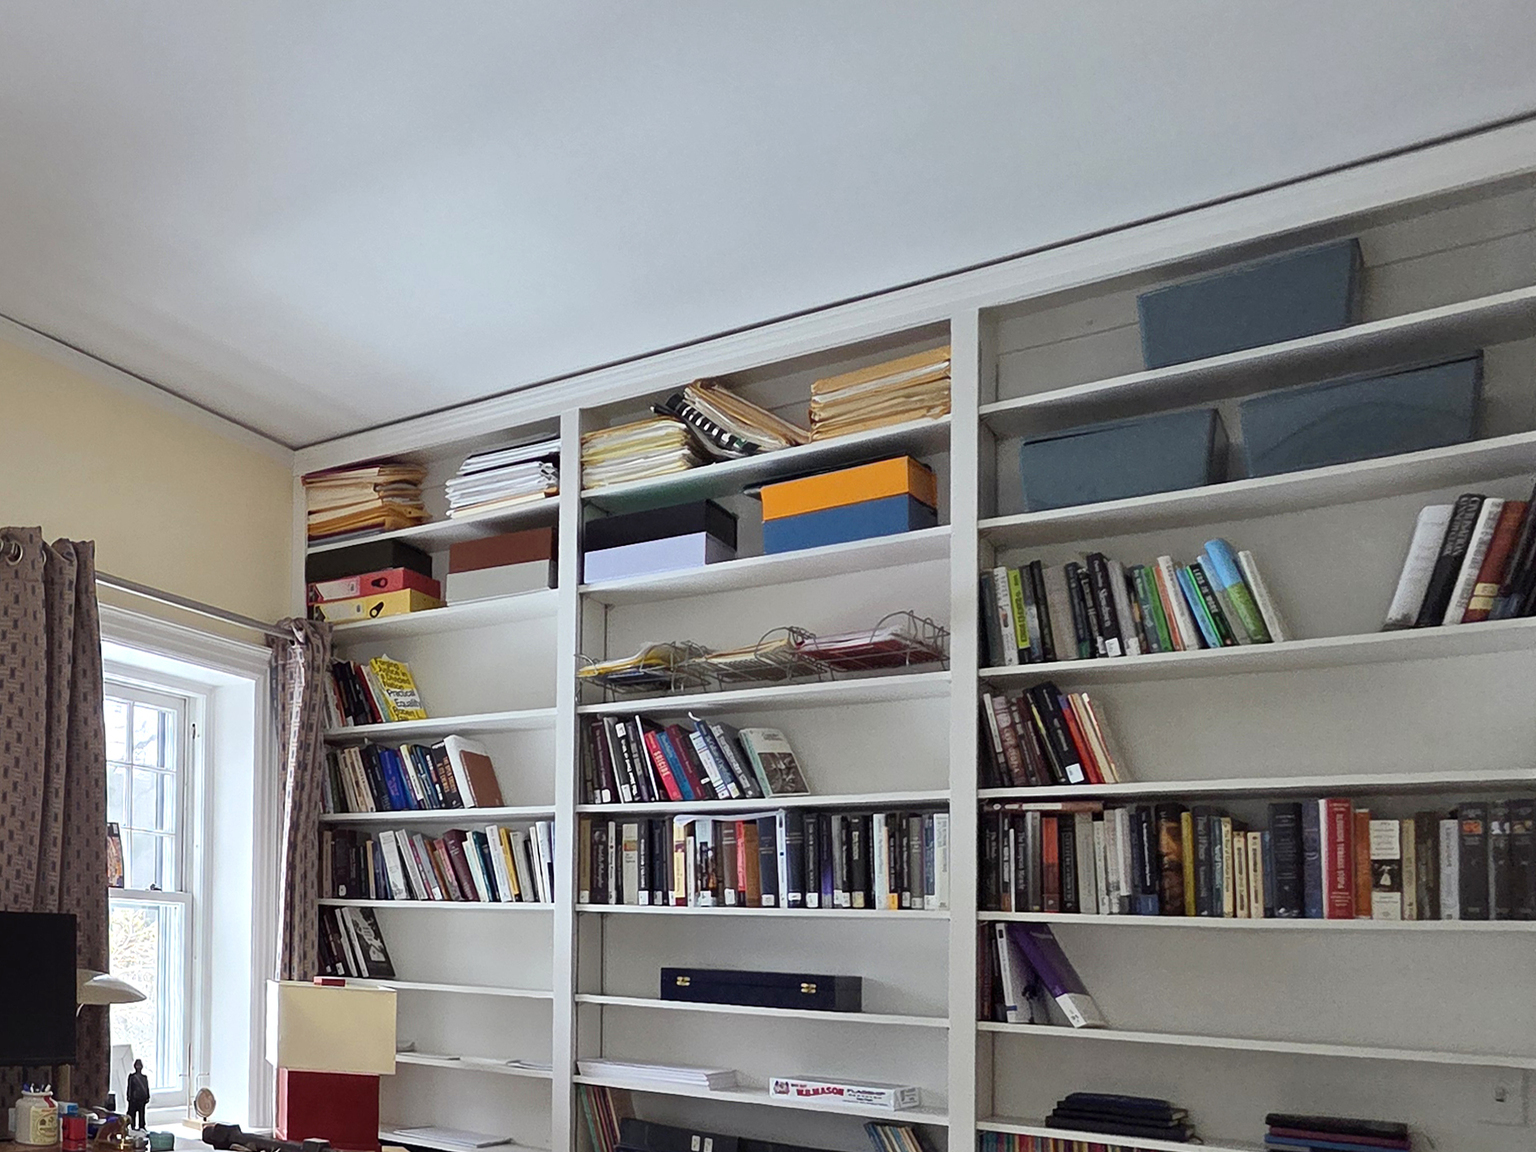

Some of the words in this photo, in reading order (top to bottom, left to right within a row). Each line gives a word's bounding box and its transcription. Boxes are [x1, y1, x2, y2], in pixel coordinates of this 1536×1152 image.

[386, 689, 416, 698] Practical
[394, 698, 423, 709] Equality
[653, 750, 671, 777] SUICIDE
